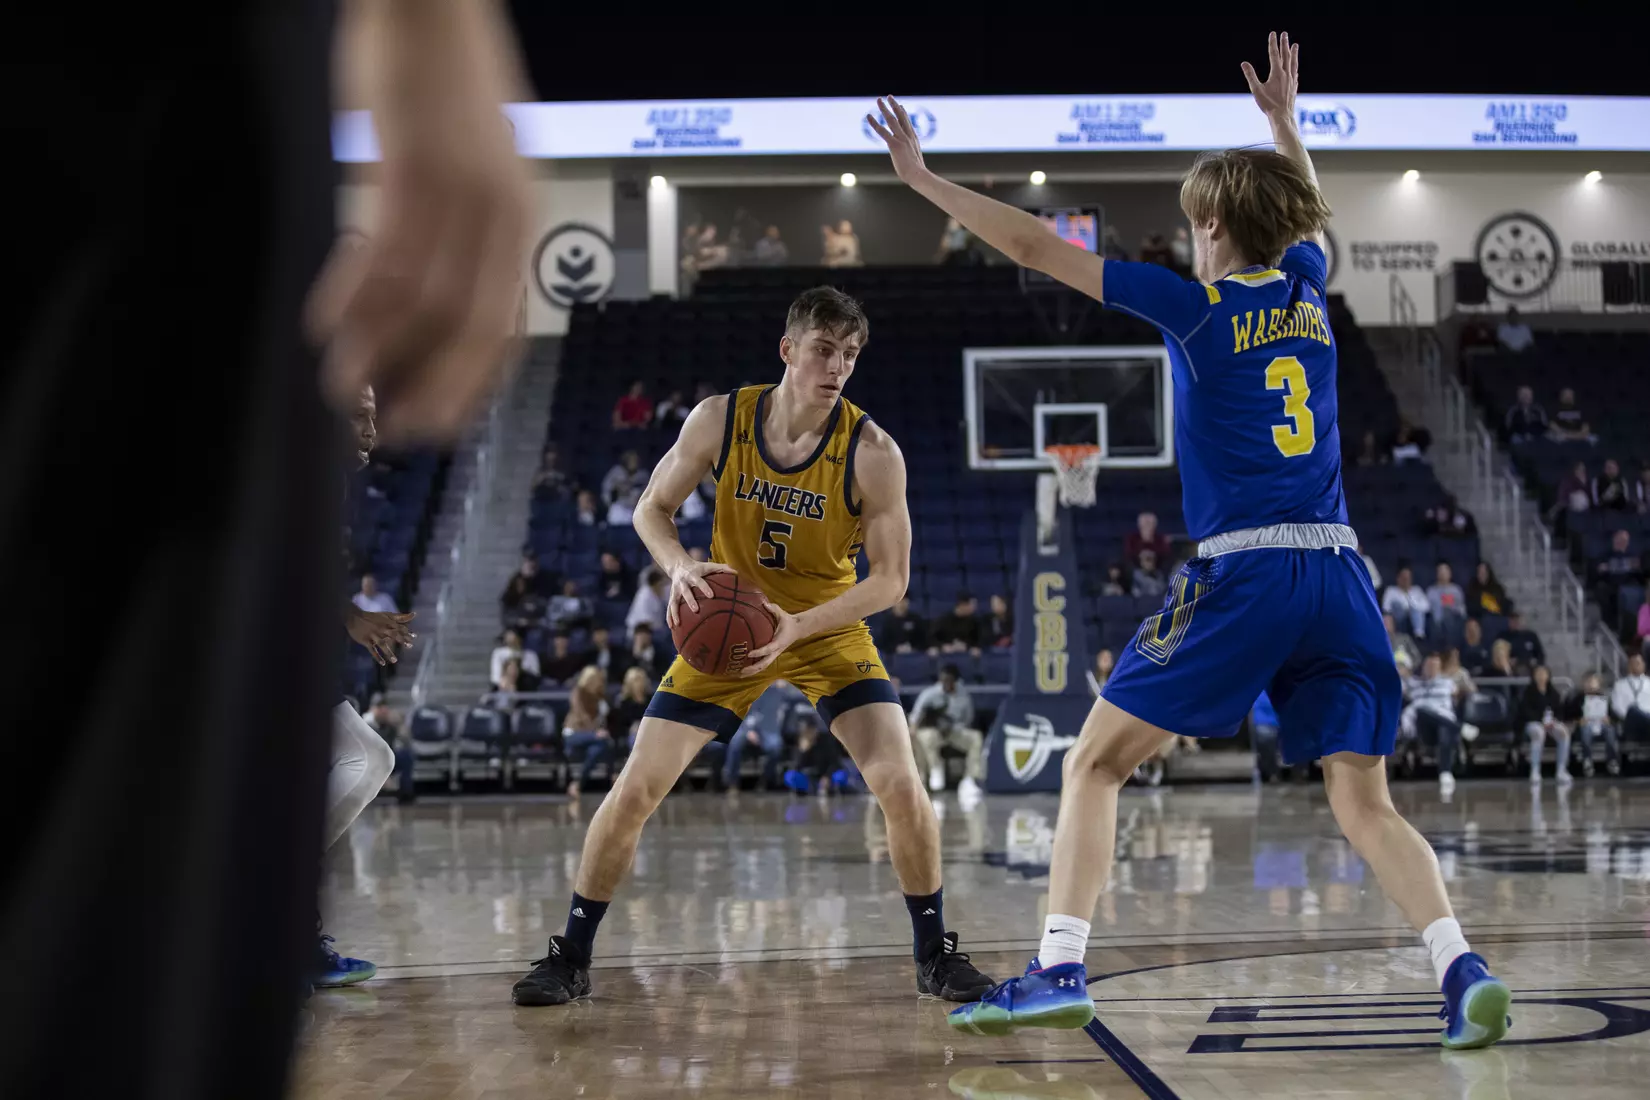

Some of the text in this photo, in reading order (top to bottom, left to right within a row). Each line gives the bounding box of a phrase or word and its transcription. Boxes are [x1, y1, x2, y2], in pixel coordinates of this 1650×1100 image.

[1299, 110, 1339, 126] FOX
[1350, 258, 1376, 272] TO
[1571, 241, 1650, 256] GLOBALL
[1231, 301, 1331, 354] WARRIORS
[1264, 355, 1316, 458] 3
[825, 453, 845, 465] WAC
[734, 472, 827, 521] LANCERS
[757, 518, 793, 570] 5
[1033, 571, 1069, 694] CBU
